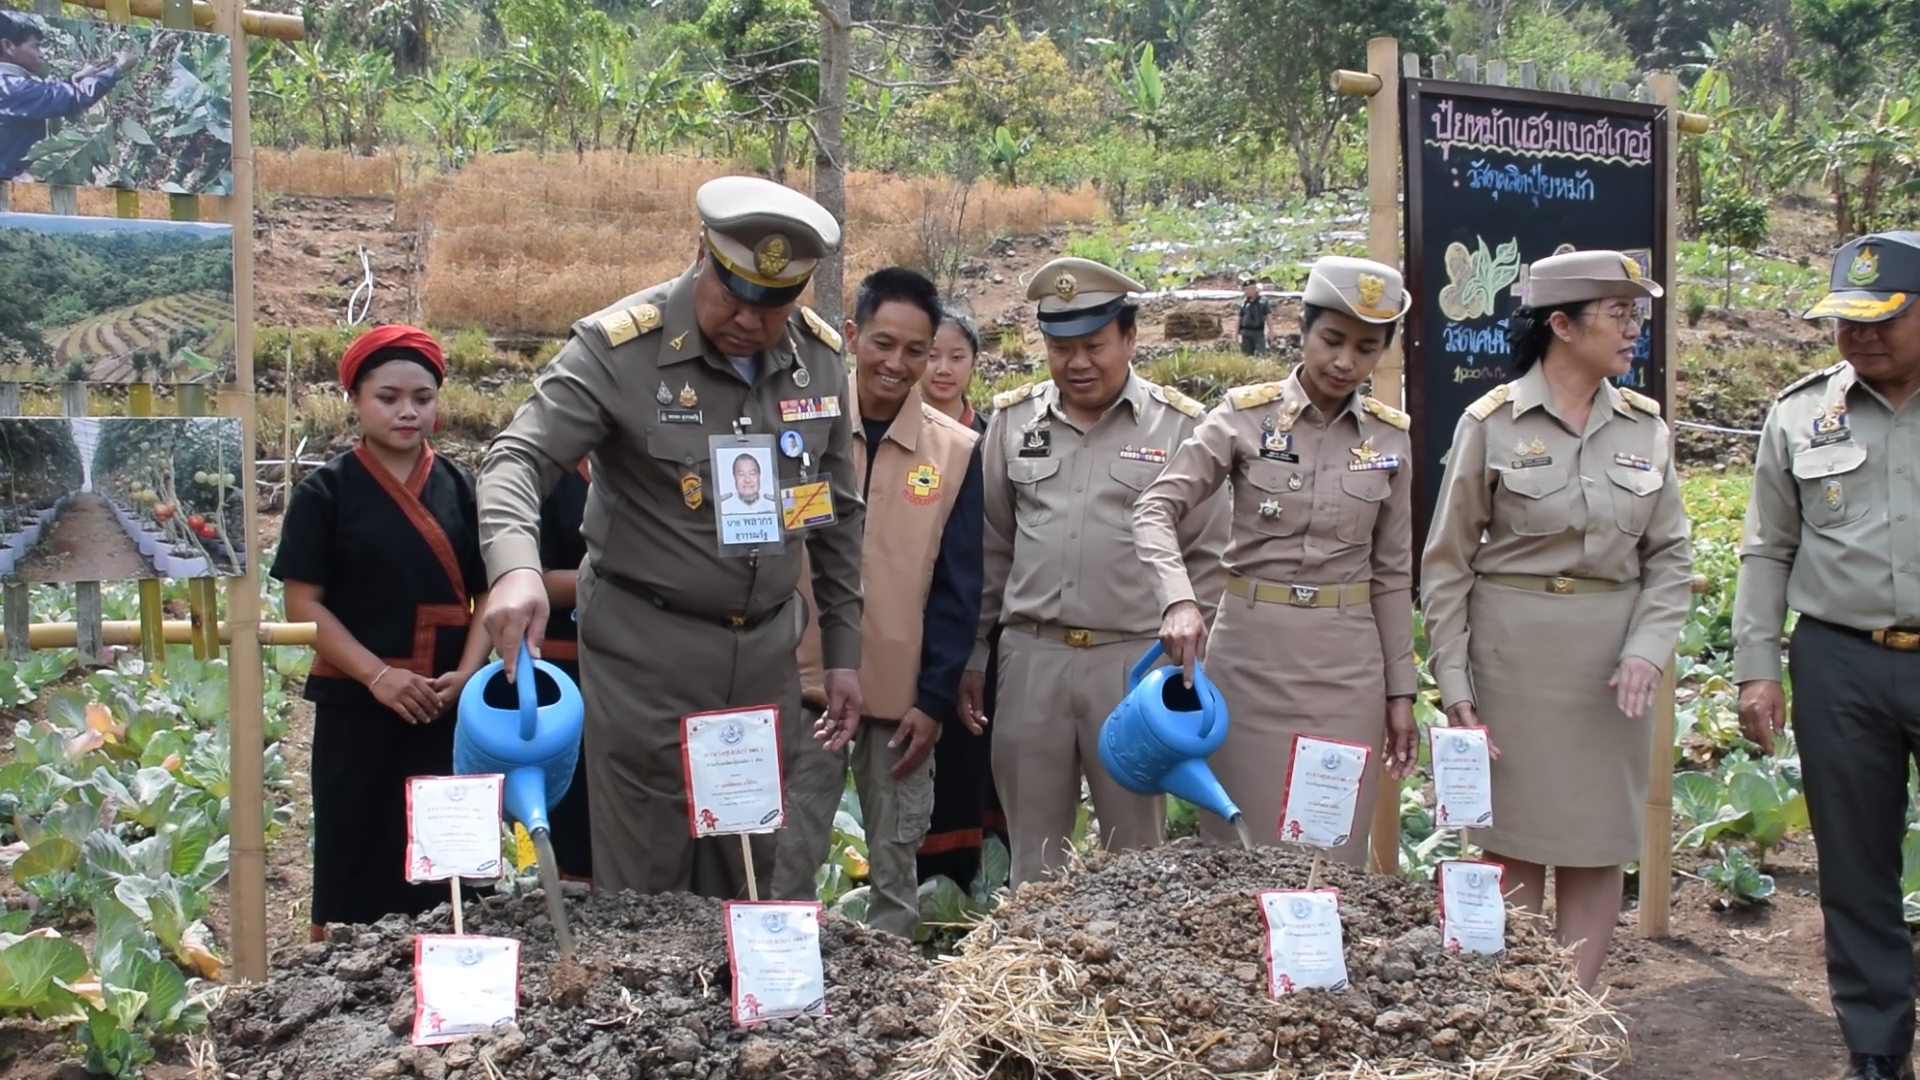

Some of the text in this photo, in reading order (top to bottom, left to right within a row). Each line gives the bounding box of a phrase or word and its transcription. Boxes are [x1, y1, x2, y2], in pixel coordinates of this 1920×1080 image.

[1431, 100, 1651, 160] ปุ๋ยหมักแฮมเบอร์เกอร์
[1467, 158, 1595, 208] วัสดุผลิตปุ๋ยหมัก
[727, 517, 773, 527] นาย พลากร
[735, 529, 768, 541] สุวรรณรัฐ
